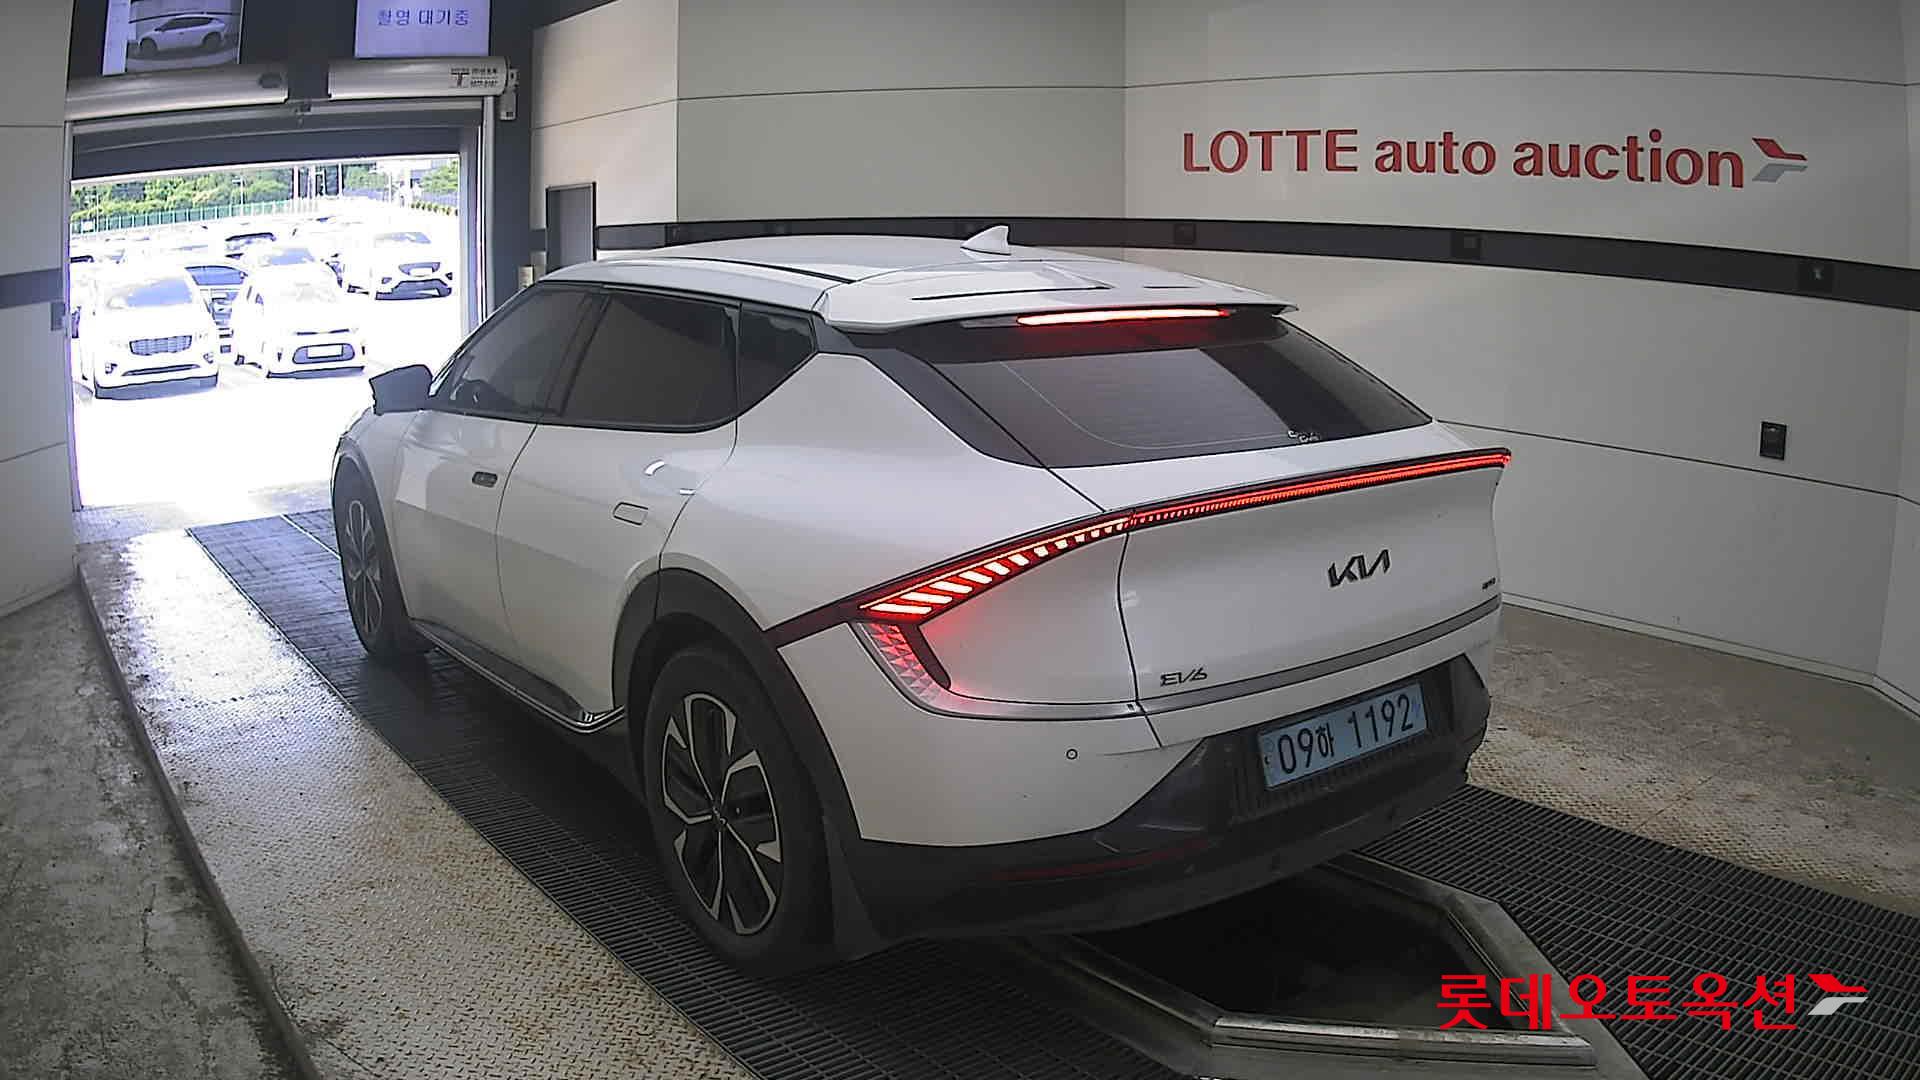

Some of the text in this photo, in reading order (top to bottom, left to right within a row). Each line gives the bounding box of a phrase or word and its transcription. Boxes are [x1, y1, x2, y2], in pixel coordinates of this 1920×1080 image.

[418, 8, 468, 26] 대기중
[1184, 129, 1744, 188] LOTTE auto auction
[1160, 667, 1208, 687] EV6
[1277, 693, 1414, 775] 09하 1192
